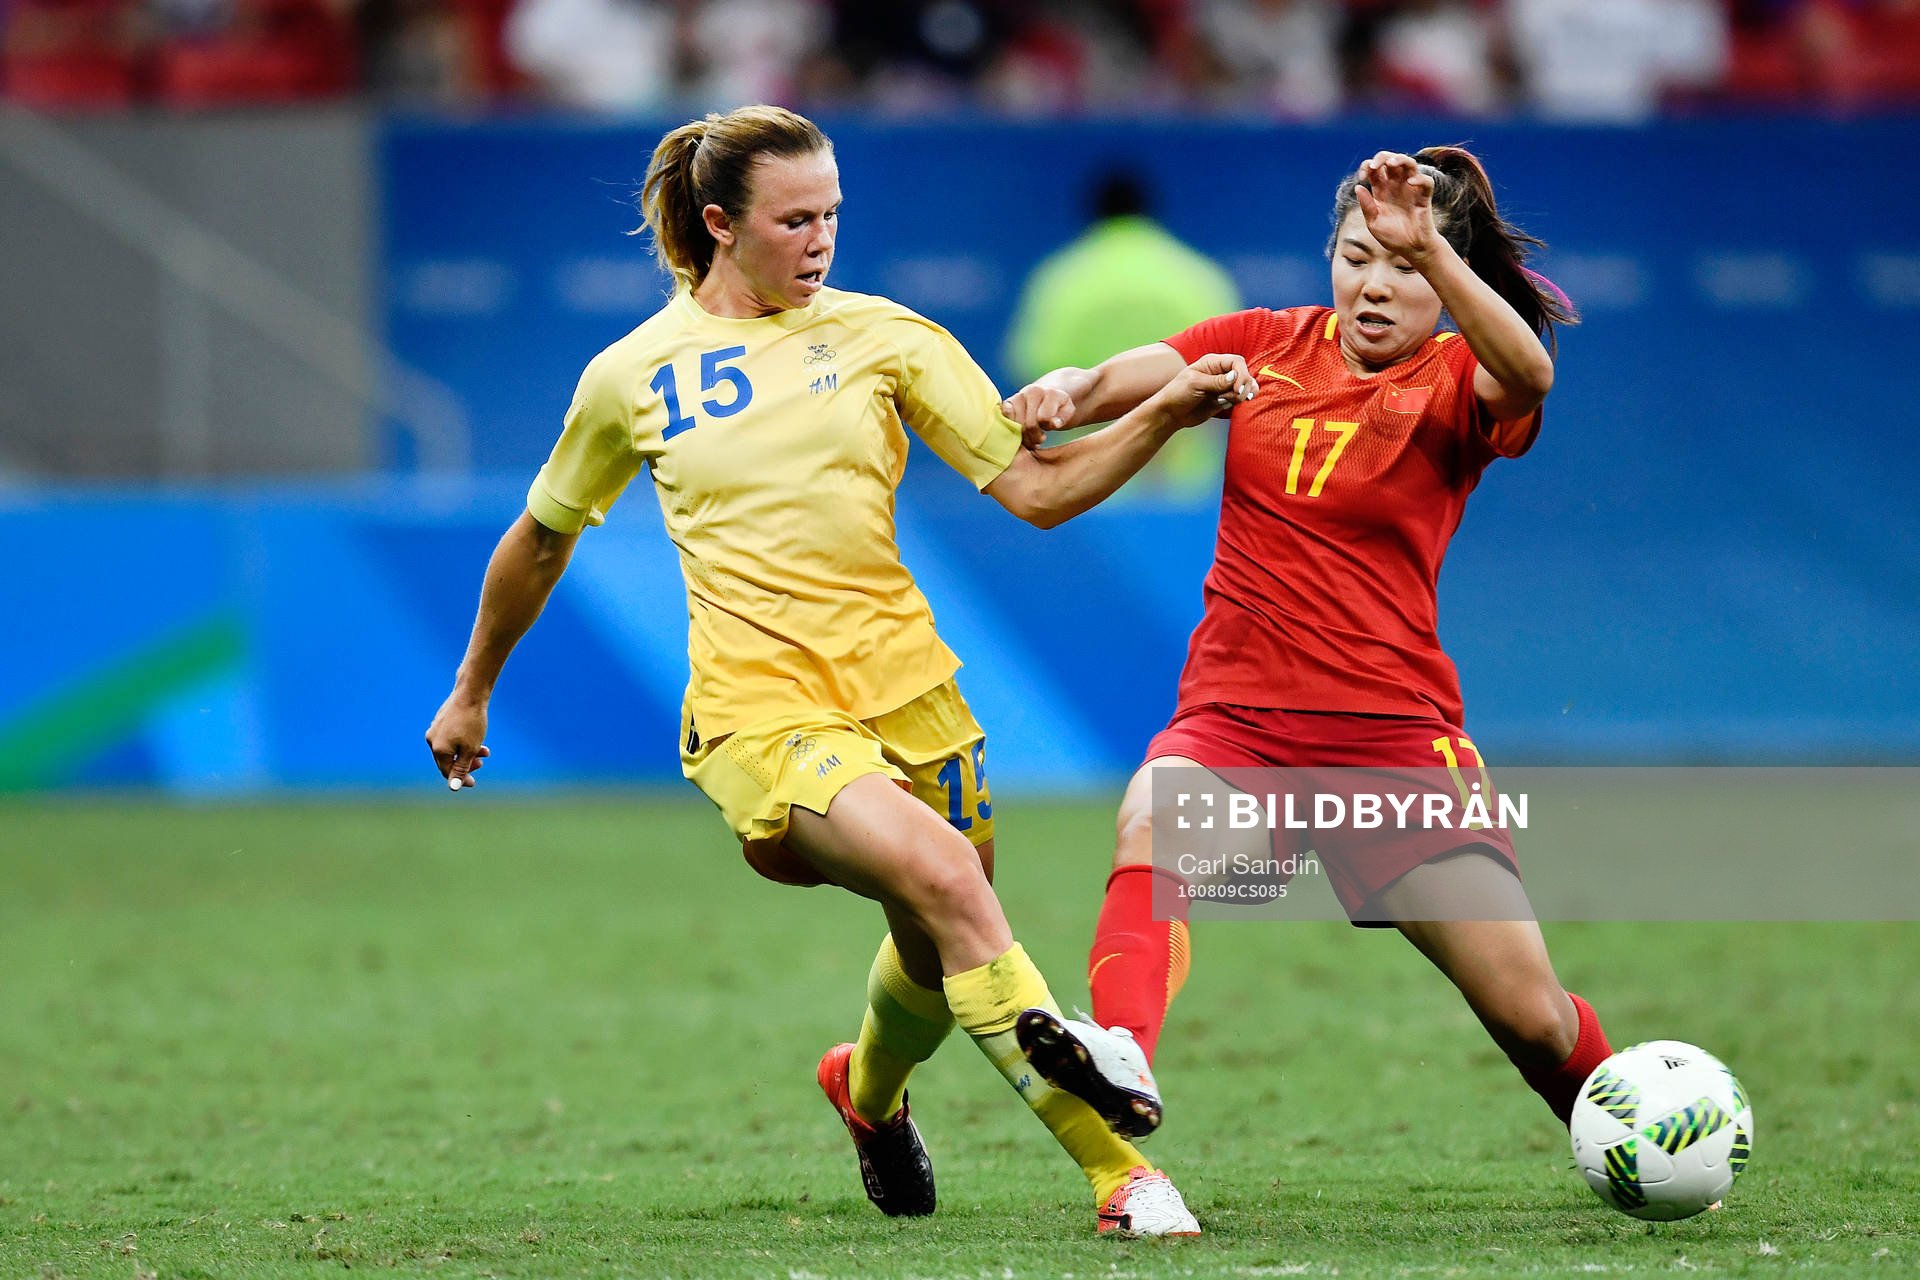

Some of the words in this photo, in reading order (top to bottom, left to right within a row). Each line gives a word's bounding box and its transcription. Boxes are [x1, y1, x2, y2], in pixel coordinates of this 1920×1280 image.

[650, 345, 753, 442] 15
[1284, 418, 1360, 497] 17
[1432, 736, 1492, 810] 17
